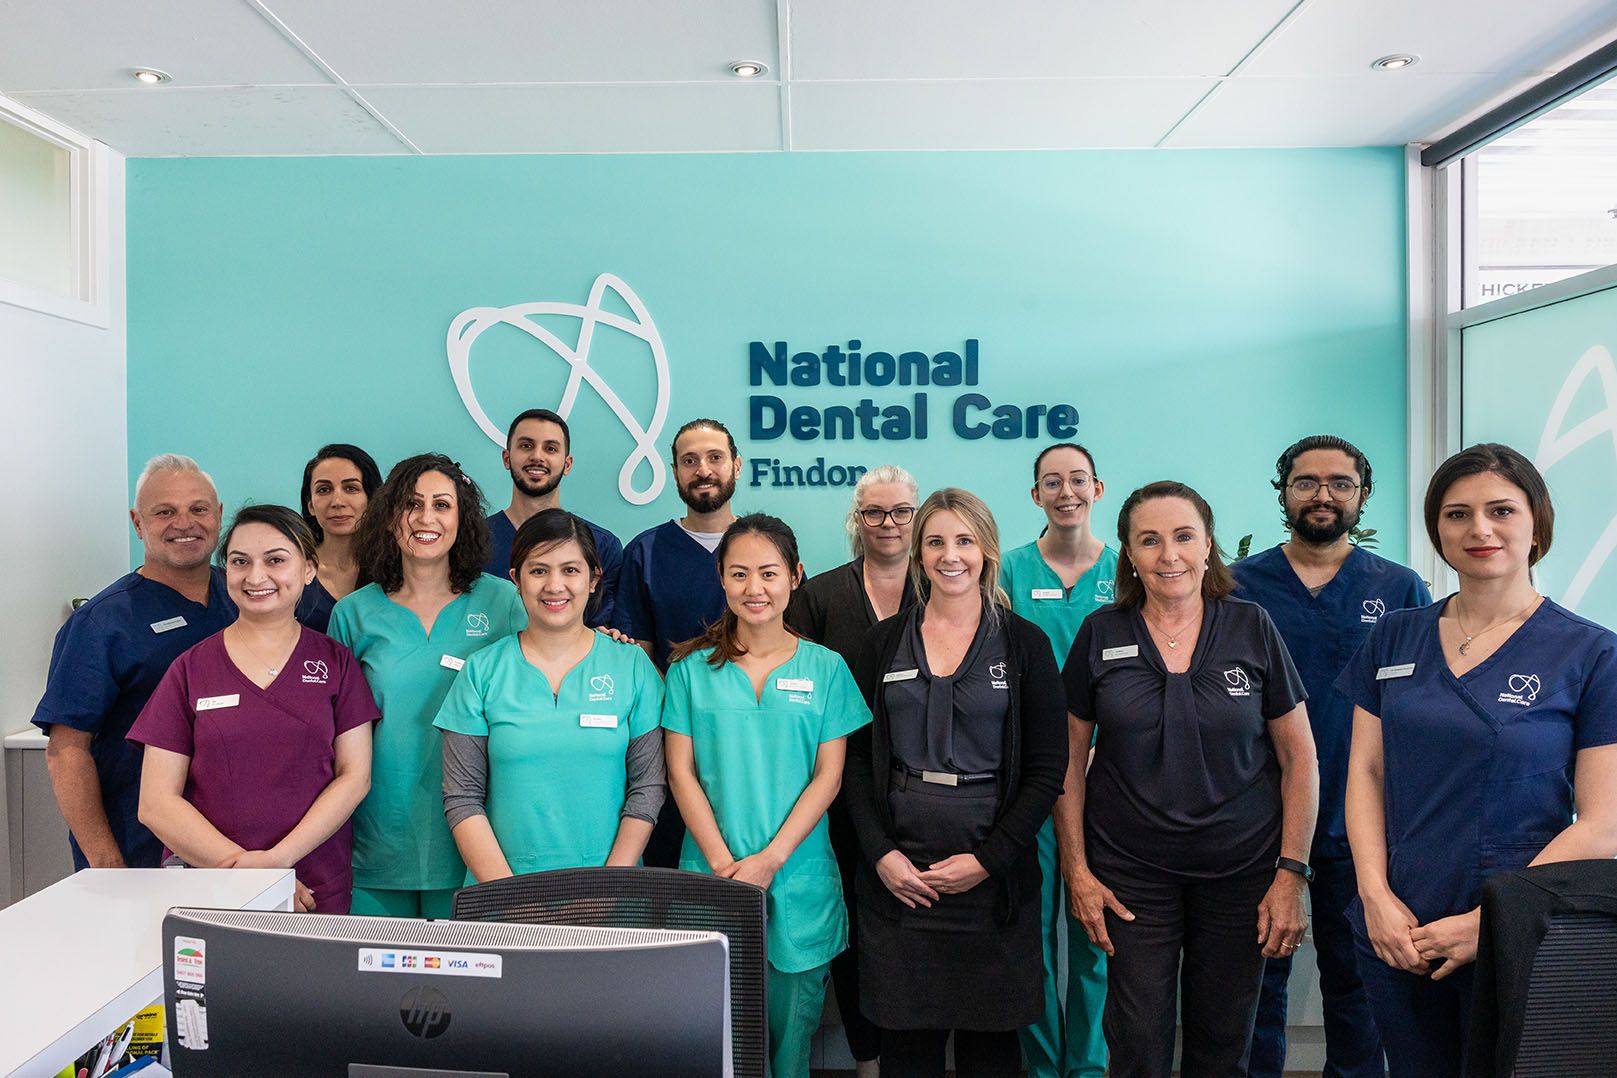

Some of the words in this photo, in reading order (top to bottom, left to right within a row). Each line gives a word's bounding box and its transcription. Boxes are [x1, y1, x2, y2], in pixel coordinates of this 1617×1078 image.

[750, 339, 979, 387] National
[750, 393, 928, 440] Dental
[953, 393, 1080, 440] Care
[1499, 692, 1523, 700] National
[1517, 699, 1531, 707] Care
[448, 960, 469, 969] VISA
[475, 962, 496, 970] eftpos
[407, 986, 444, 1039] hp
